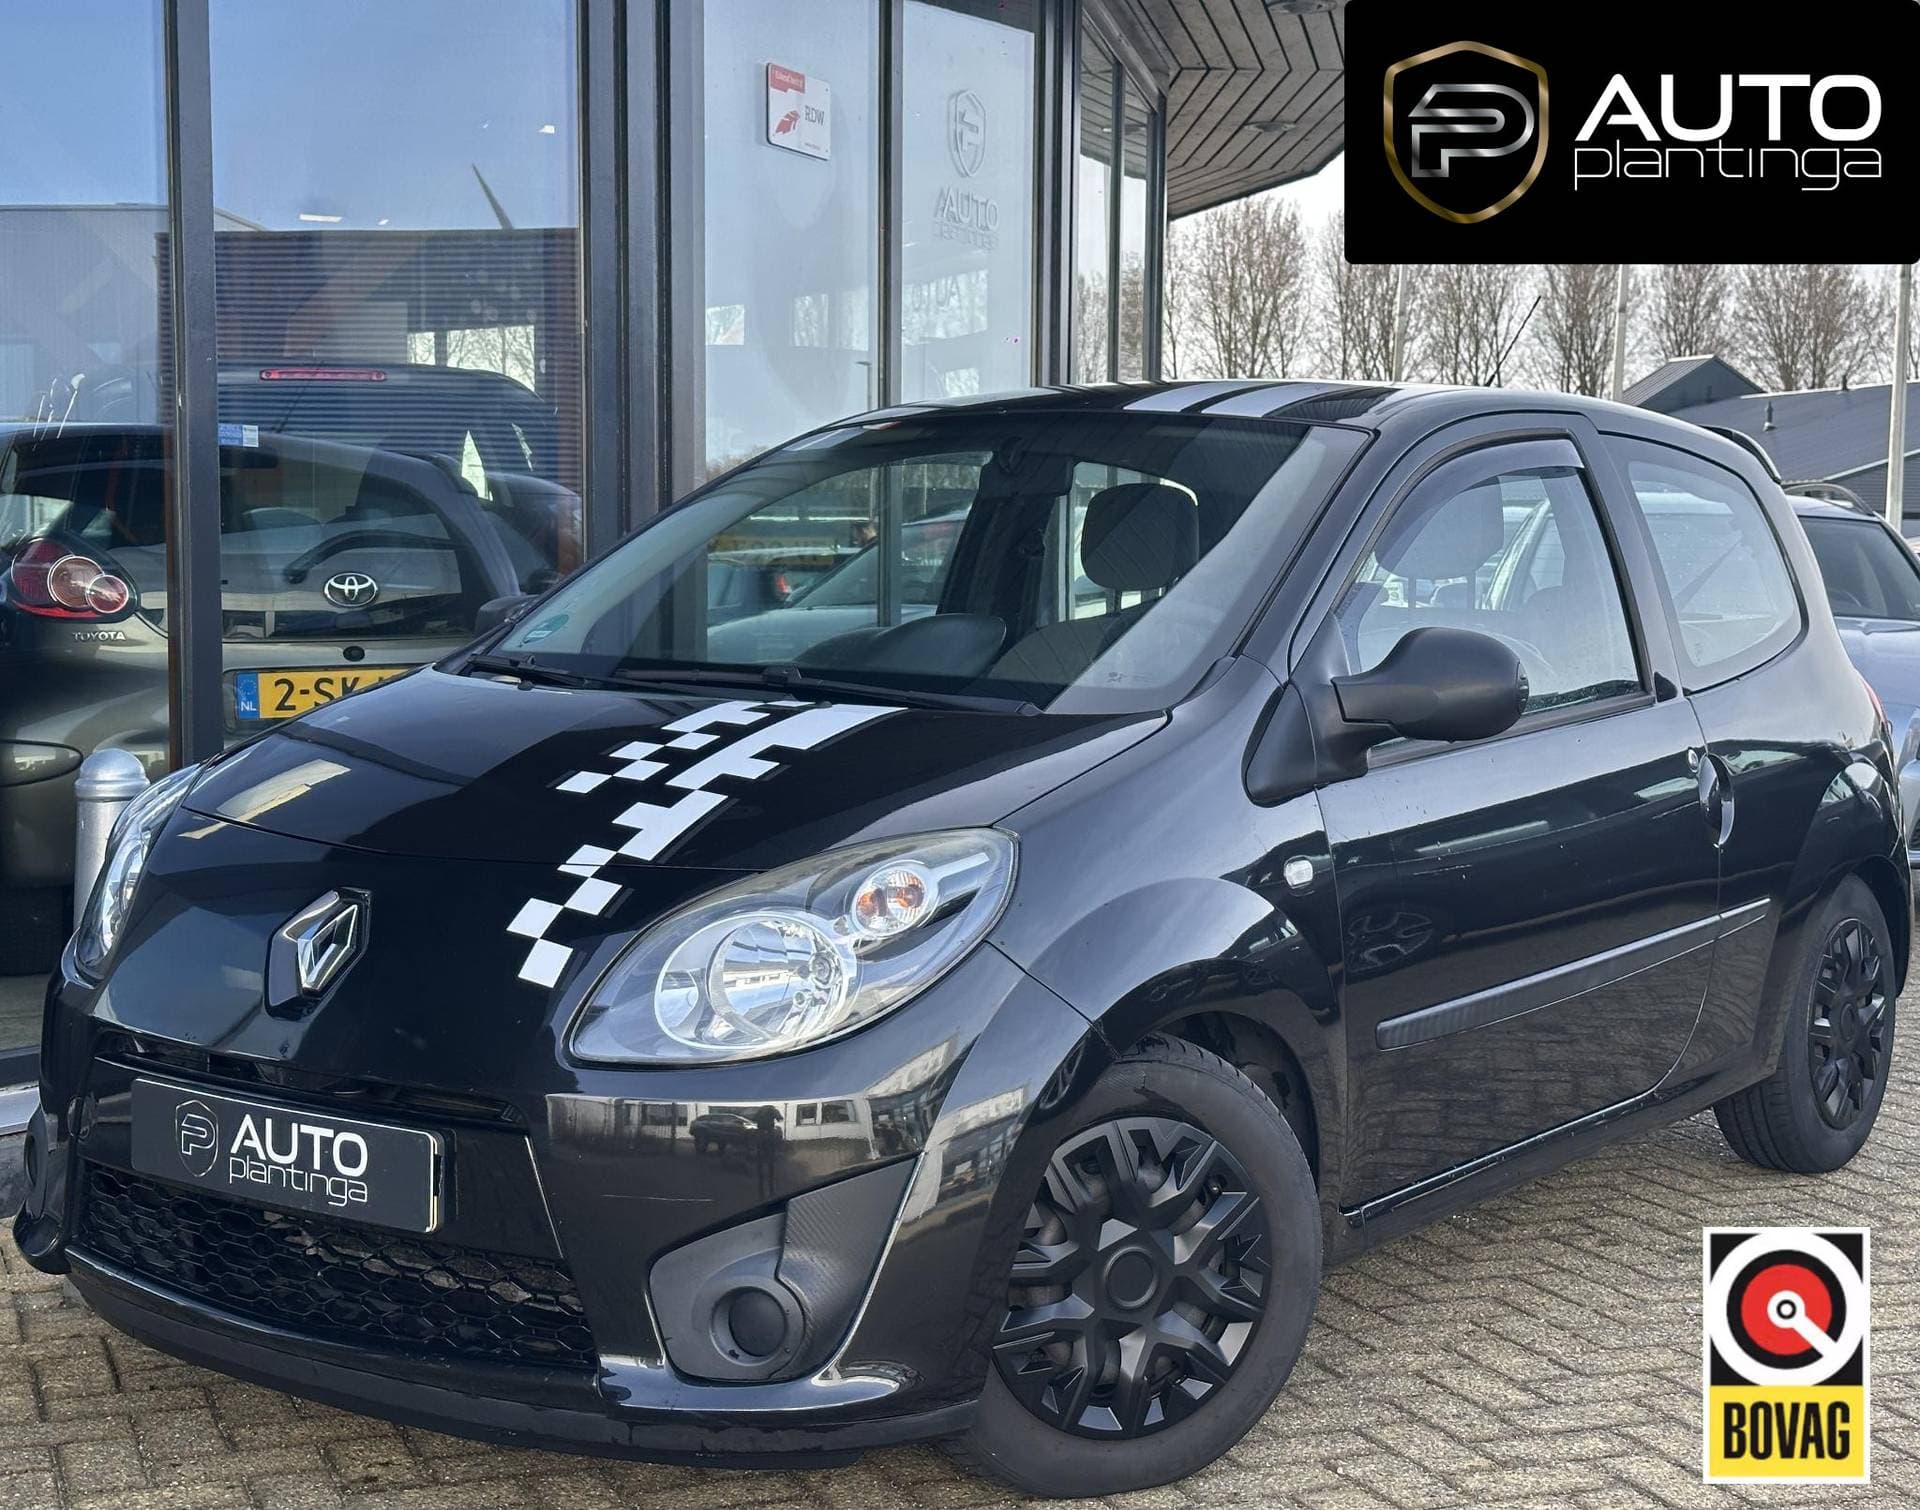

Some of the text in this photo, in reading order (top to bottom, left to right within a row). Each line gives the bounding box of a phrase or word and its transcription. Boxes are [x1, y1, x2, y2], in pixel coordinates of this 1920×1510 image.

[804, 105, 825, 126] RDW
[941, 186, 998, 231] AUTO
[72, 631, 126, 641] TOYOTA
[241, 701, 257, 711] NL
[274, 676, 384, 711] 2-SK
[230, 1113, 368, 1177] AUTO
[229, 1155, 368, 1207] plantinga
